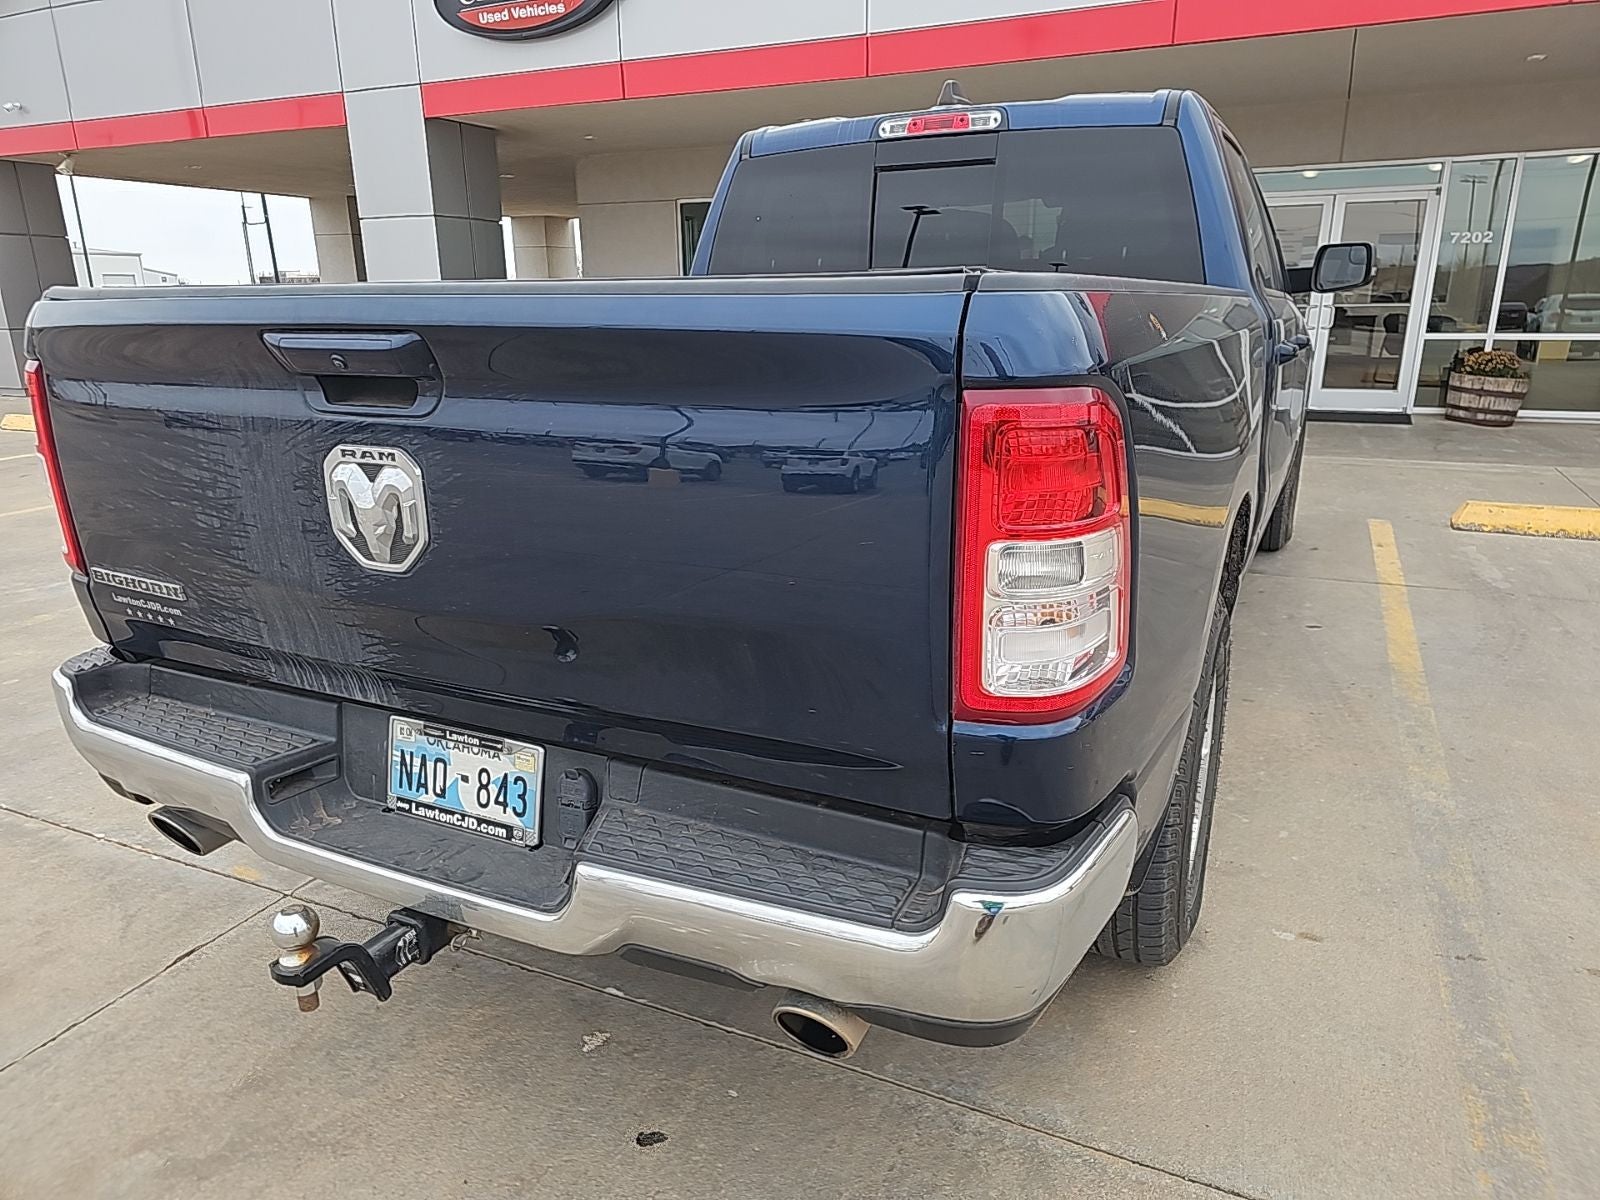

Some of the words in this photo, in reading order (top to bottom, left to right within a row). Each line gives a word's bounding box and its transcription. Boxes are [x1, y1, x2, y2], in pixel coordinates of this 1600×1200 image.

[478, 9, 509, 24] Used
[511, 2, 566, 18] Vehicles
[1450, 231, 1494, 244] 7202
[340, 449, 396, 462] RAM
[112, 592, 182, 616] LawtonCJDR.com
[445, 730, 480, 746] Lawton
[399, 749, 448, 799] NAQ
[476, 768, 528, 818] 843
[411, 803, 507, 838] LawtonCJD.com
